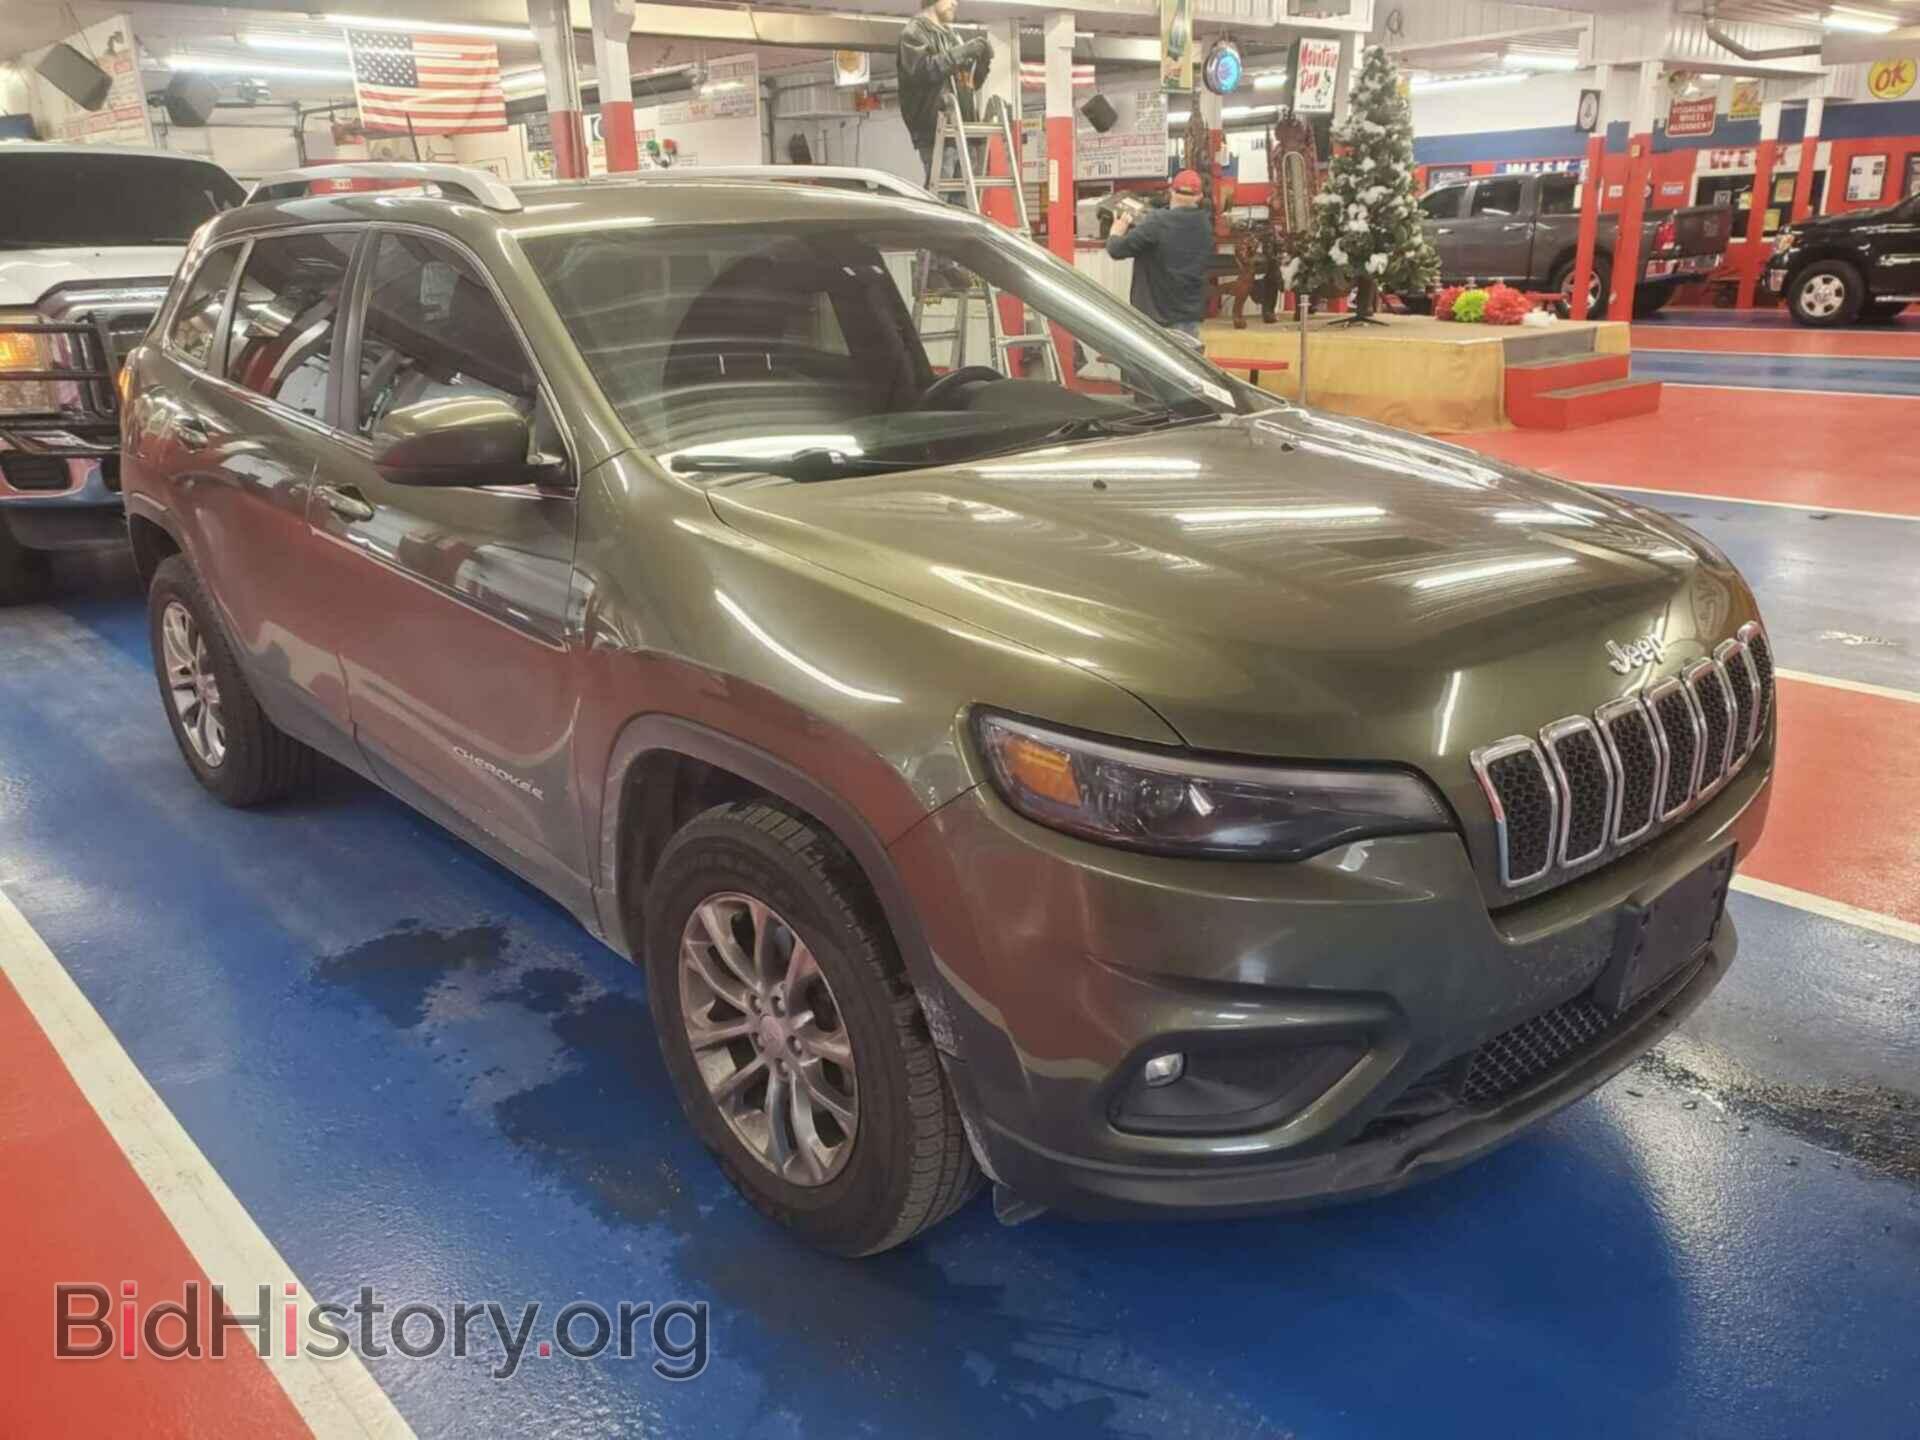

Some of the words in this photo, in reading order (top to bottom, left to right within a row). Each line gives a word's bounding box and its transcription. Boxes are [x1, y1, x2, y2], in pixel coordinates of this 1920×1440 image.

[1874, 60, 1908, 92] OK
[1710, 144, 1788, 169] WEK
[1604, 633, 1665, 673] Jeep
[453, 746, 545, 801] CHEROKEE
